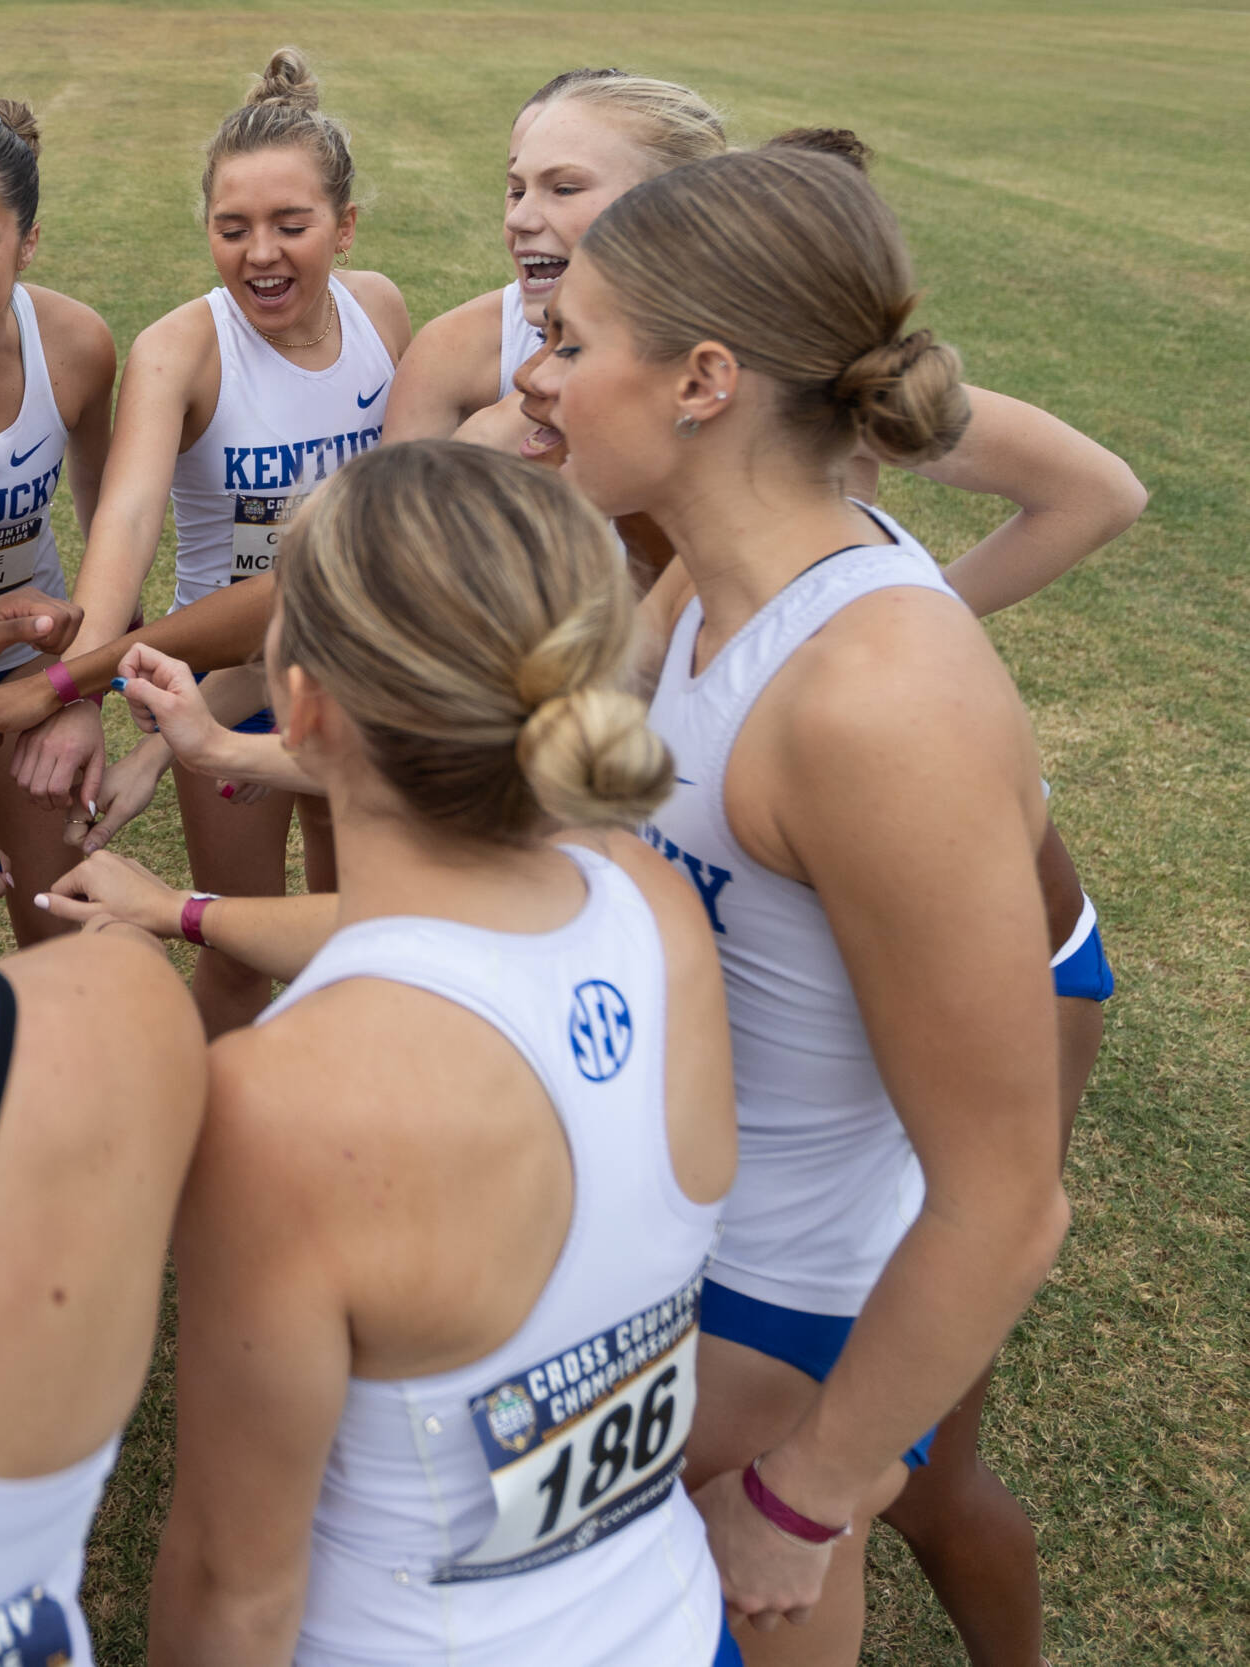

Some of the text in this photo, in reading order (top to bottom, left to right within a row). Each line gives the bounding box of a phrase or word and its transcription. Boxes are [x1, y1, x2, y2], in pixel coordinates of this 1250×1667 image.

[572, 979, 632, 1082] SEC
[527, 1337, 609, 1402] CROSS
[535, 1364, 678, 1540] 186
